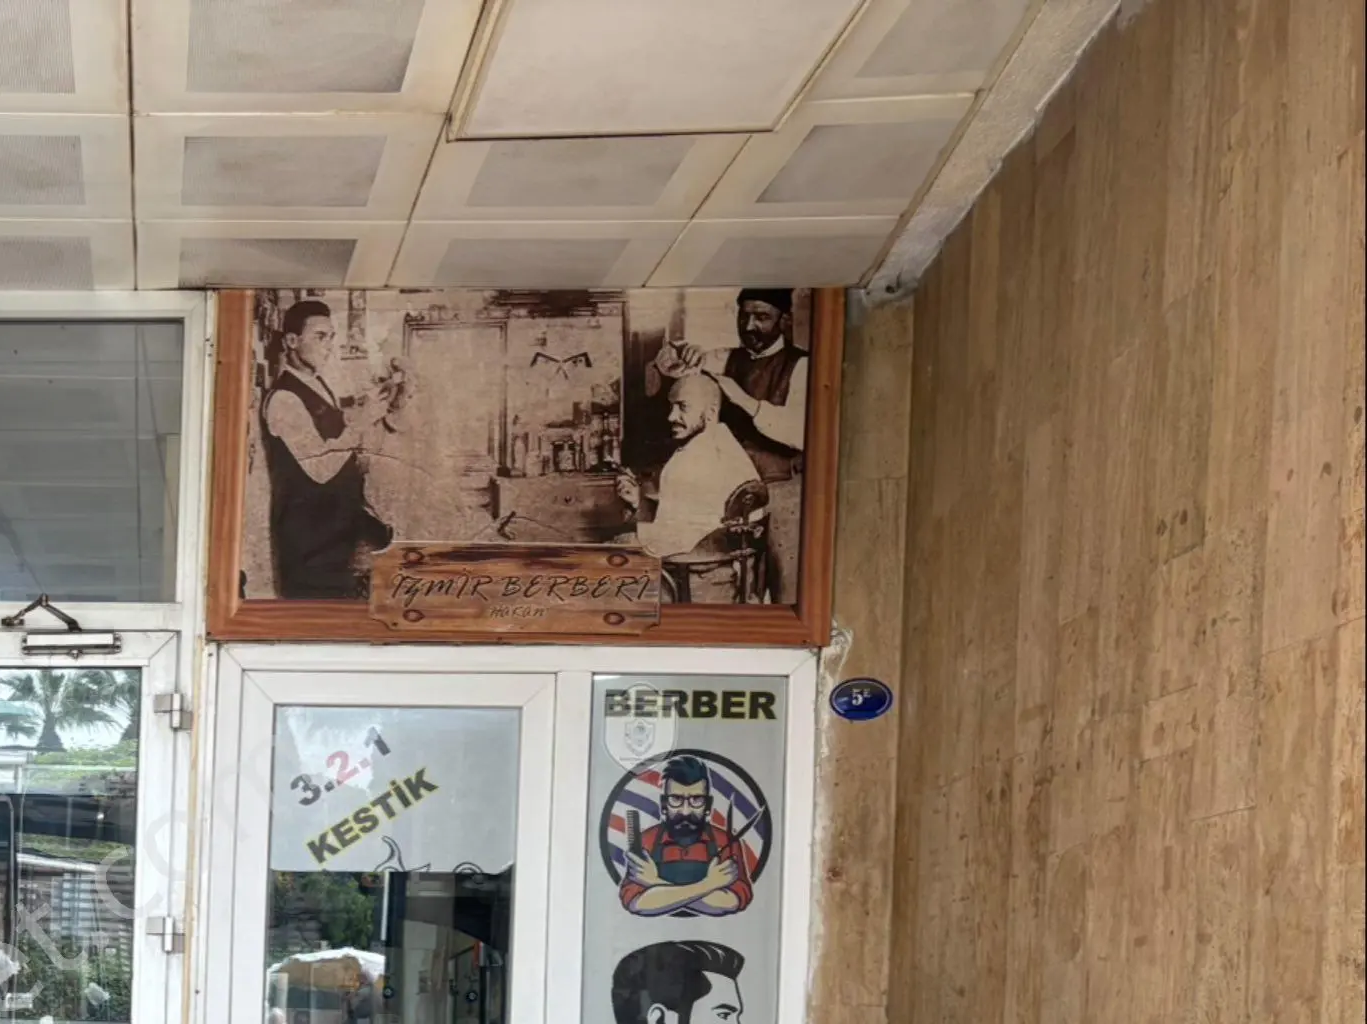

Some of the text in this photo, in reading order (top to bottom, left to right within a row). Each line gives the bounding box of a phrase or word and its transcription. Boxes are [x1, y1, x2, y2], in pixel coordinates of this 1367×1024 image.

[501, 569, 652, 603] BERBERİ
[604, 688, 777, 720] BERBER
[305, 766, 439, 865] KESTİK
